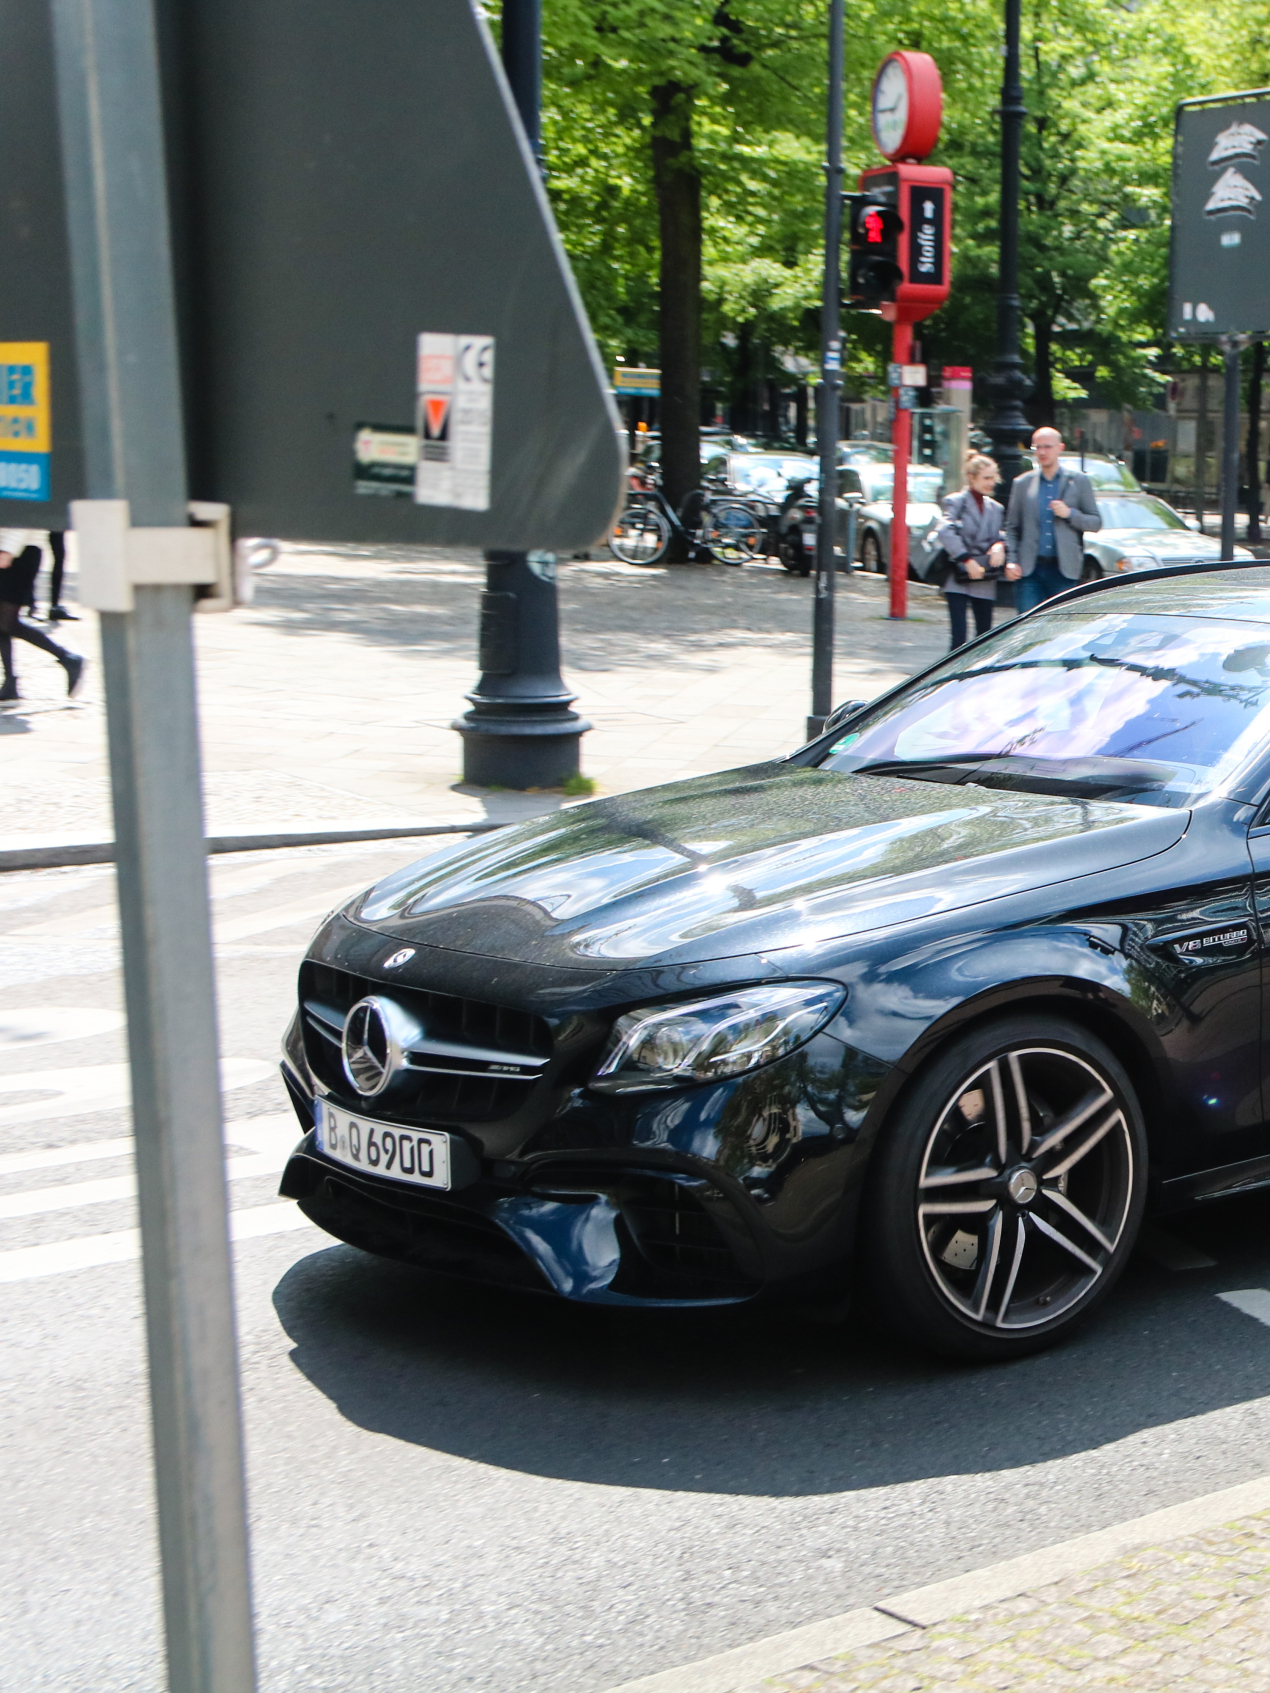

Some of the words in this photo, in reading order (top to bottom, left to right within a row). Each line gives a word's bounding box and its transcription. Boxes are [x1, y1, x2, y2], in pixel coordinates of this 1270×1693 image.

[916, 224, 936, 274] Stoffe
[1173, 939, 1202, 954] V8
[1203, 929, 1248, 945] BITURBO
[327, 1107, 339, 1151] B
[349, 1121, 362, 1163] Q
[366, 1126, 435, 1179] 6900
